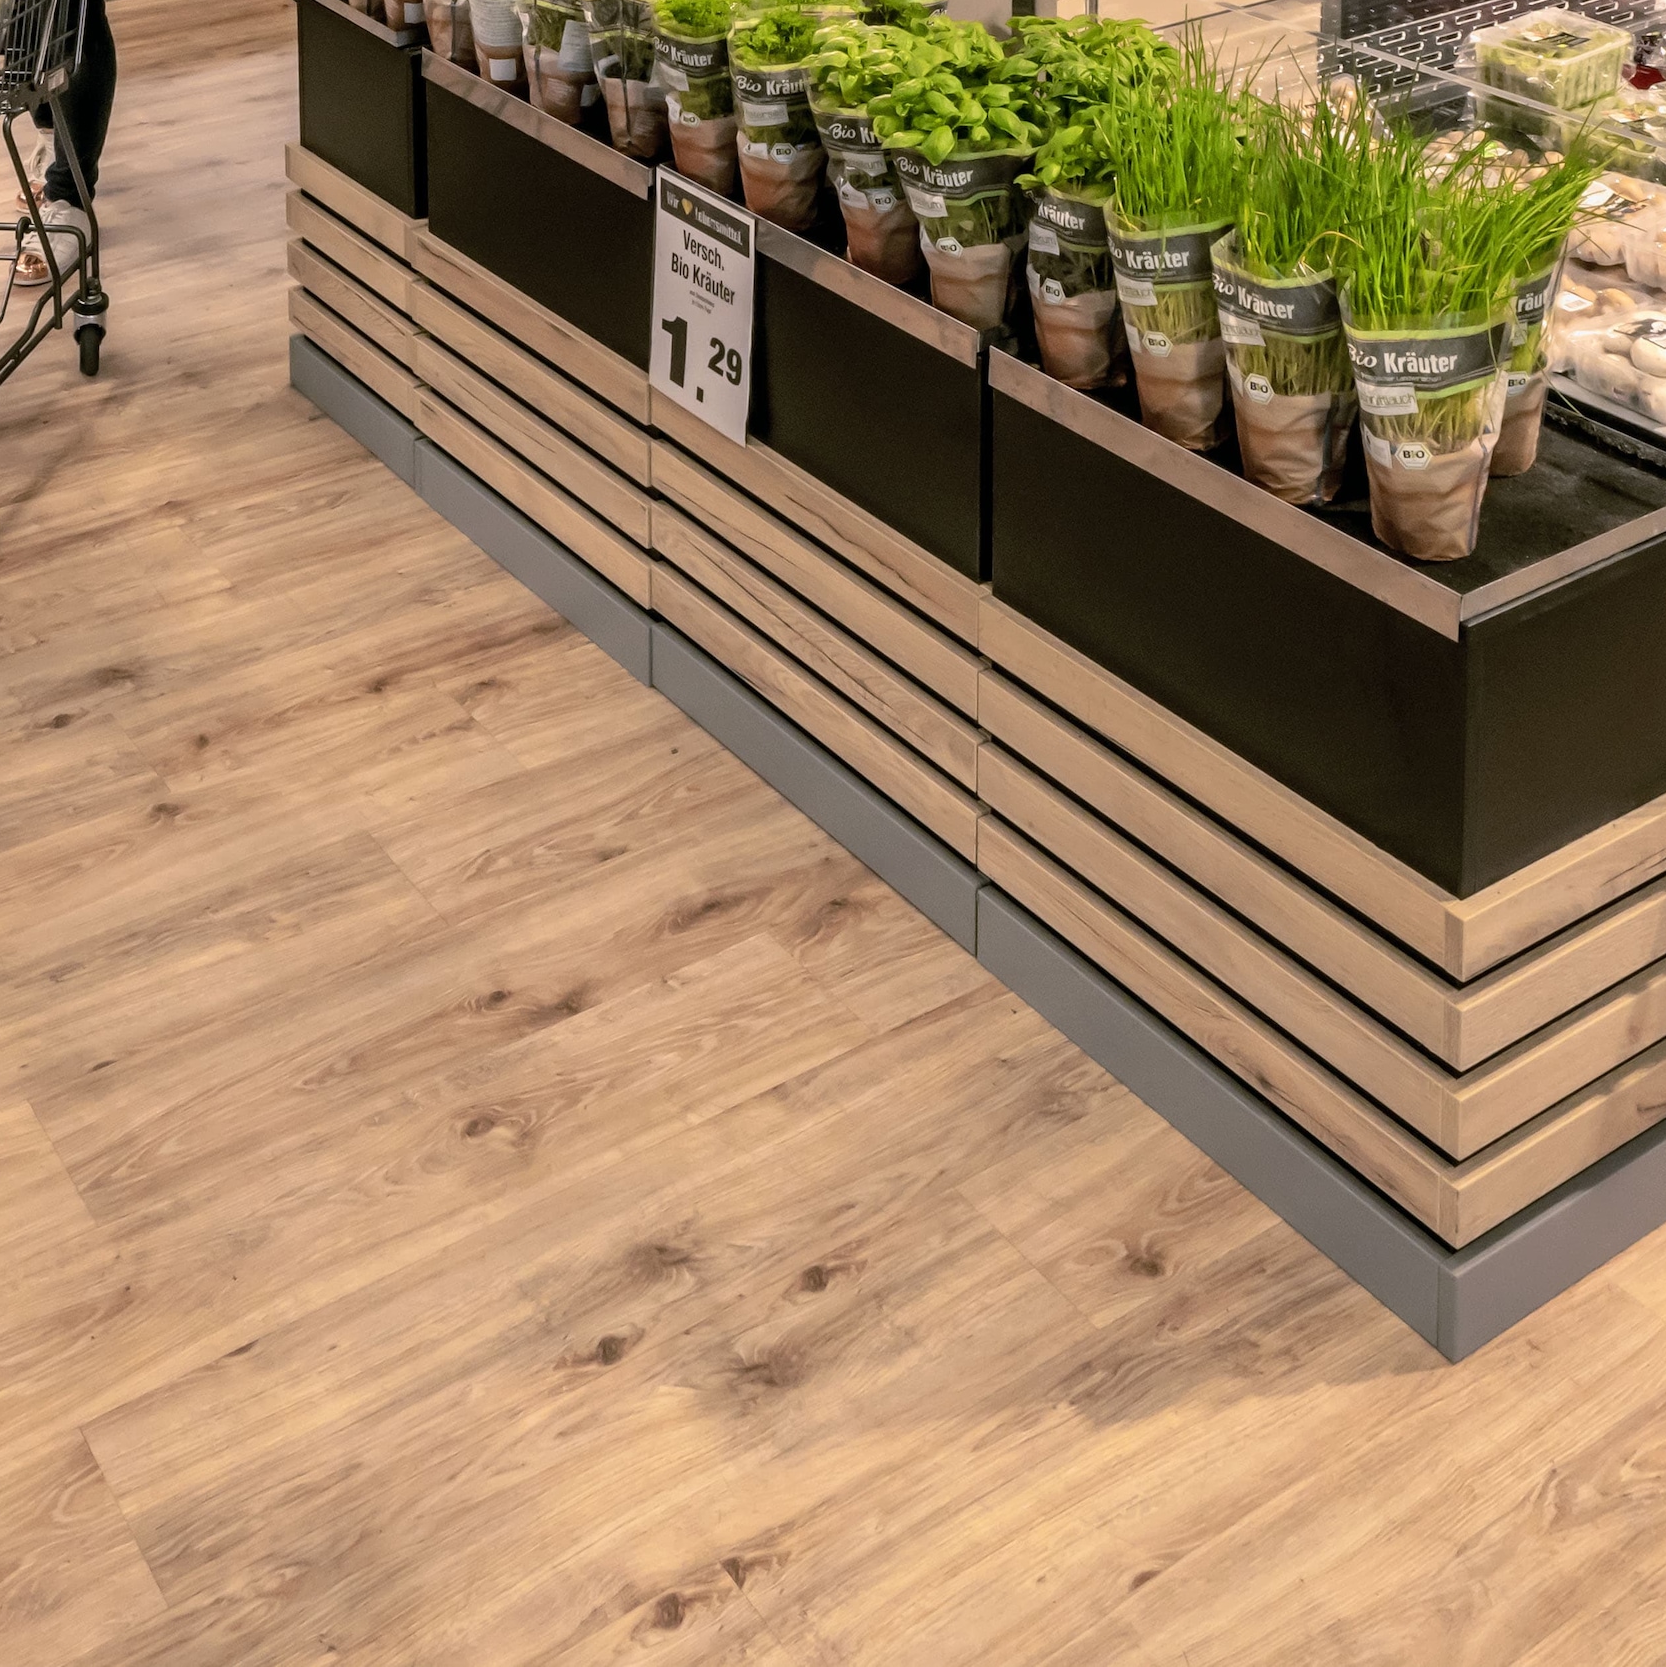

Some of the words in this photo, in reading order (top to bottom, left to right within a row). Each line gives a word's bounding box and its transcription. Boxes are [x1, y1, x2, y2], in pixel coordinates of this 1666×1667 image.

[653, 36, 669, 53] Bio
[671, 43, 714, 66] Kräuter
[735, 75, 762, 93] Bio
[766, 80, 805, 96] Kräut
[828, 122, 856, 139] Bio
[776, 148, 792, 156] BIO
[898, 157, 919, 175] Bio
[922, 167, 973, 187] Kräuter
[666, 190, 680, 210] Wir
[874, 196, 892, 206] BIO
[1037, 203, 1086, 231] Kräuter
[683, 229, 725, 272] Versch.
[940, 243, 958, 253] BIO
[1126, 248, 1190, 271] Kräuter
[671, 252, 690, 280] Bio
[692, 266, 736, 306] Kräuter
[1045, 285, 1061, 297] BIO
[1237, 292, 1295, 321] Kräuter
[1148, 338, 1167, 348] BIO
[1384, 350, 1458, 375] Kräuter
[1249, 380, 1270, 393] BIO
[1509, 377, 1526, 387] BIO
[1403, 448, 1425, 461] BIO
